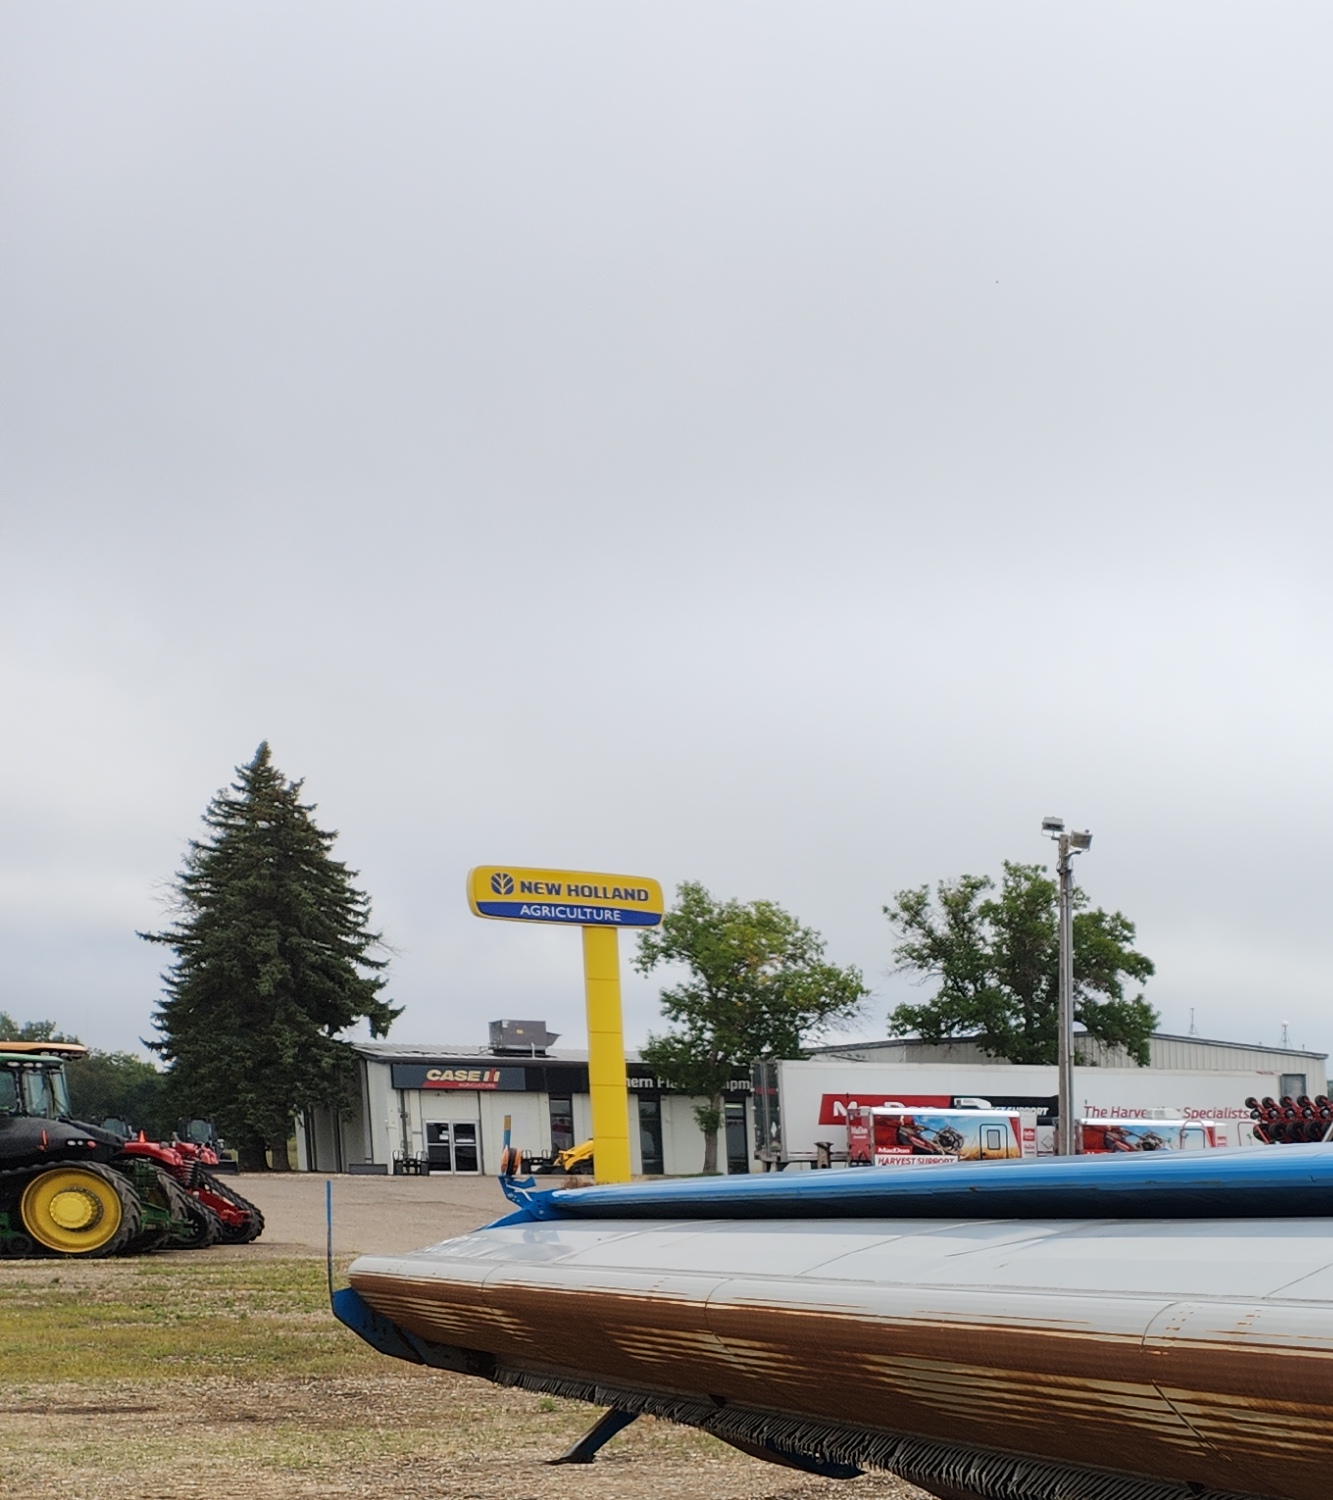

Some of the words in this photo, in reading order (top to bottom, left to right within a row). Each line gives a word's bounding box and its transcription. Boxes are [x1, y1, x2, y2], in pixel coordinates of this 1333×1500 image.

[520, 880, 562, 896] NEW
[567, 884, 649, 902] HOLLAND
[520, 905, 621, 922] AGRICULTURE
[426, 1069, 482, 1081] CASE
[1084, 1106, 1107, 1118] The
[1183, 1106, 1250, 1119] Specialists
[878, 1157, 916, 1166] HARVEST
